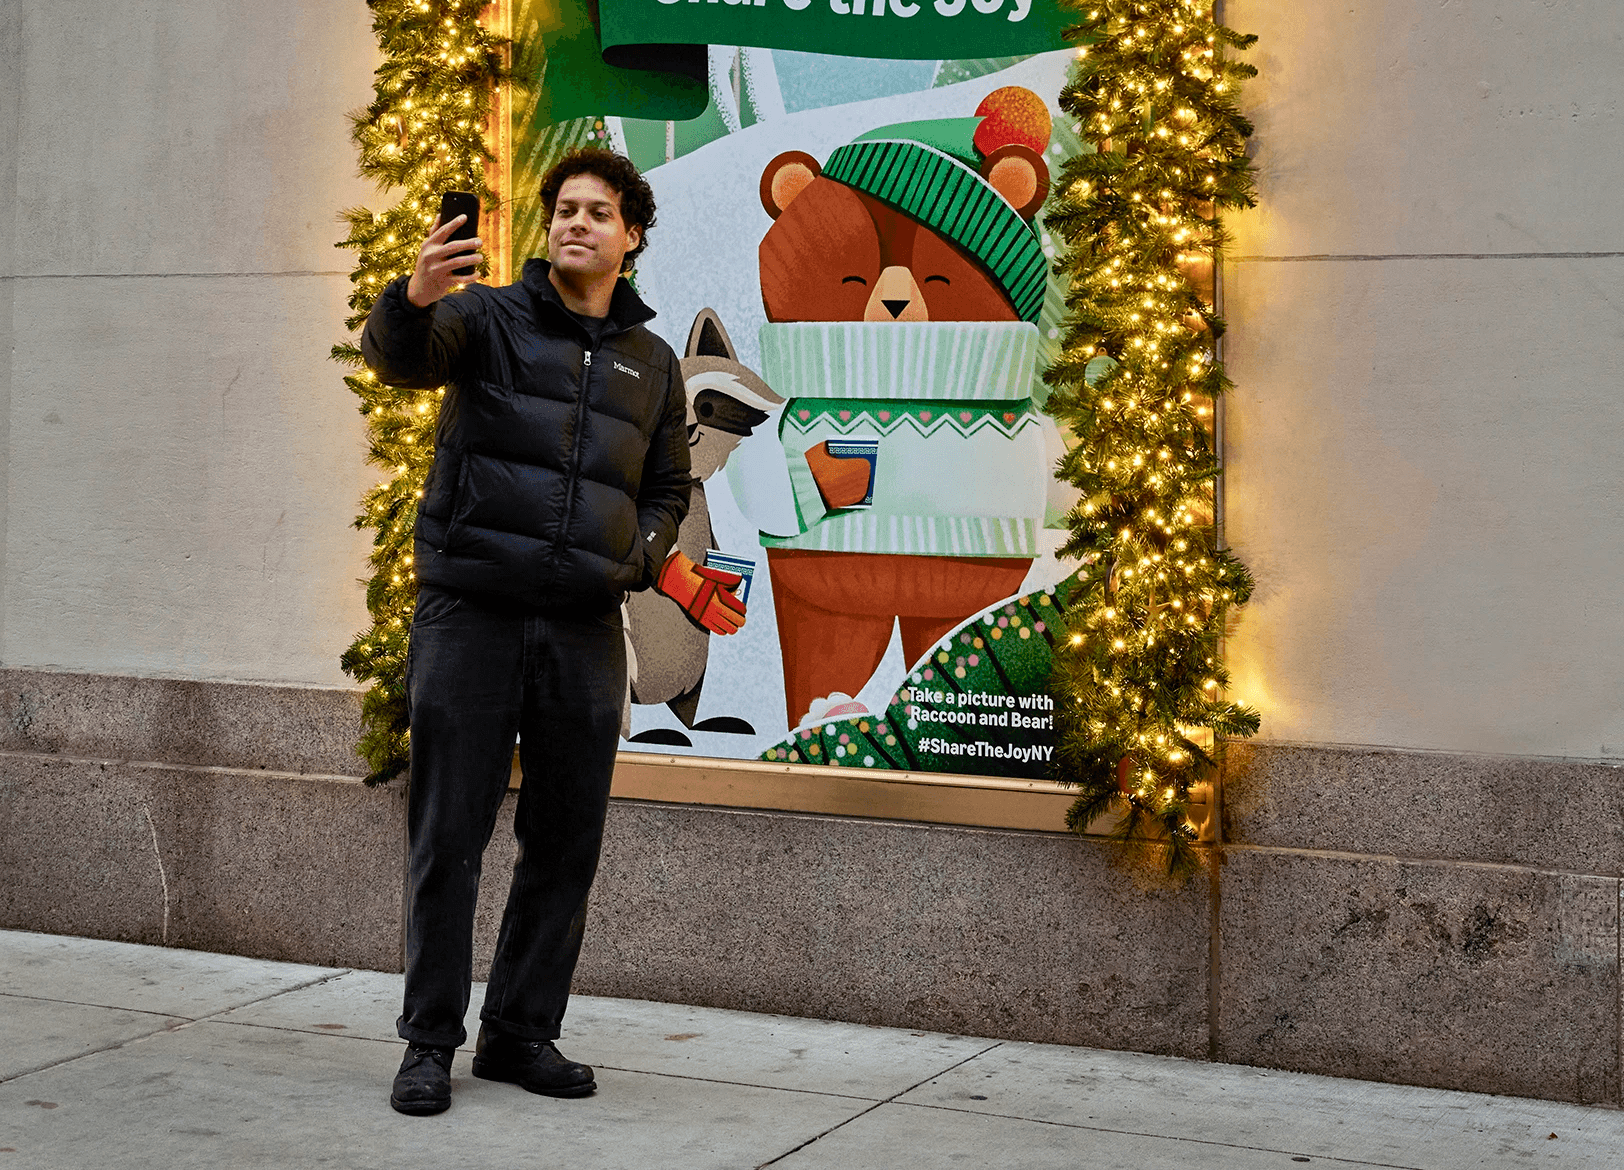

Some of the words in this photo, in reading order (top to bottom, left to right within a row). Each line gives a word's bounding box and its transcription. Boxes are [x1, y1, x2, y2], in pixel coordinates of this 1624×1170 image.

[908, 687, 943, 703] Take
[945, 693, 955, 704] a
[958, 690, 1015, 708] picture
[1018, 694, 1054, 710] with
[910, 706, 976, 725] Raccoon
[979, 712, 1008, 727] and
[1011, 712, 1054, 730] Bear!
[918, 737, 1054, 763] #ShareTheJoyNY
